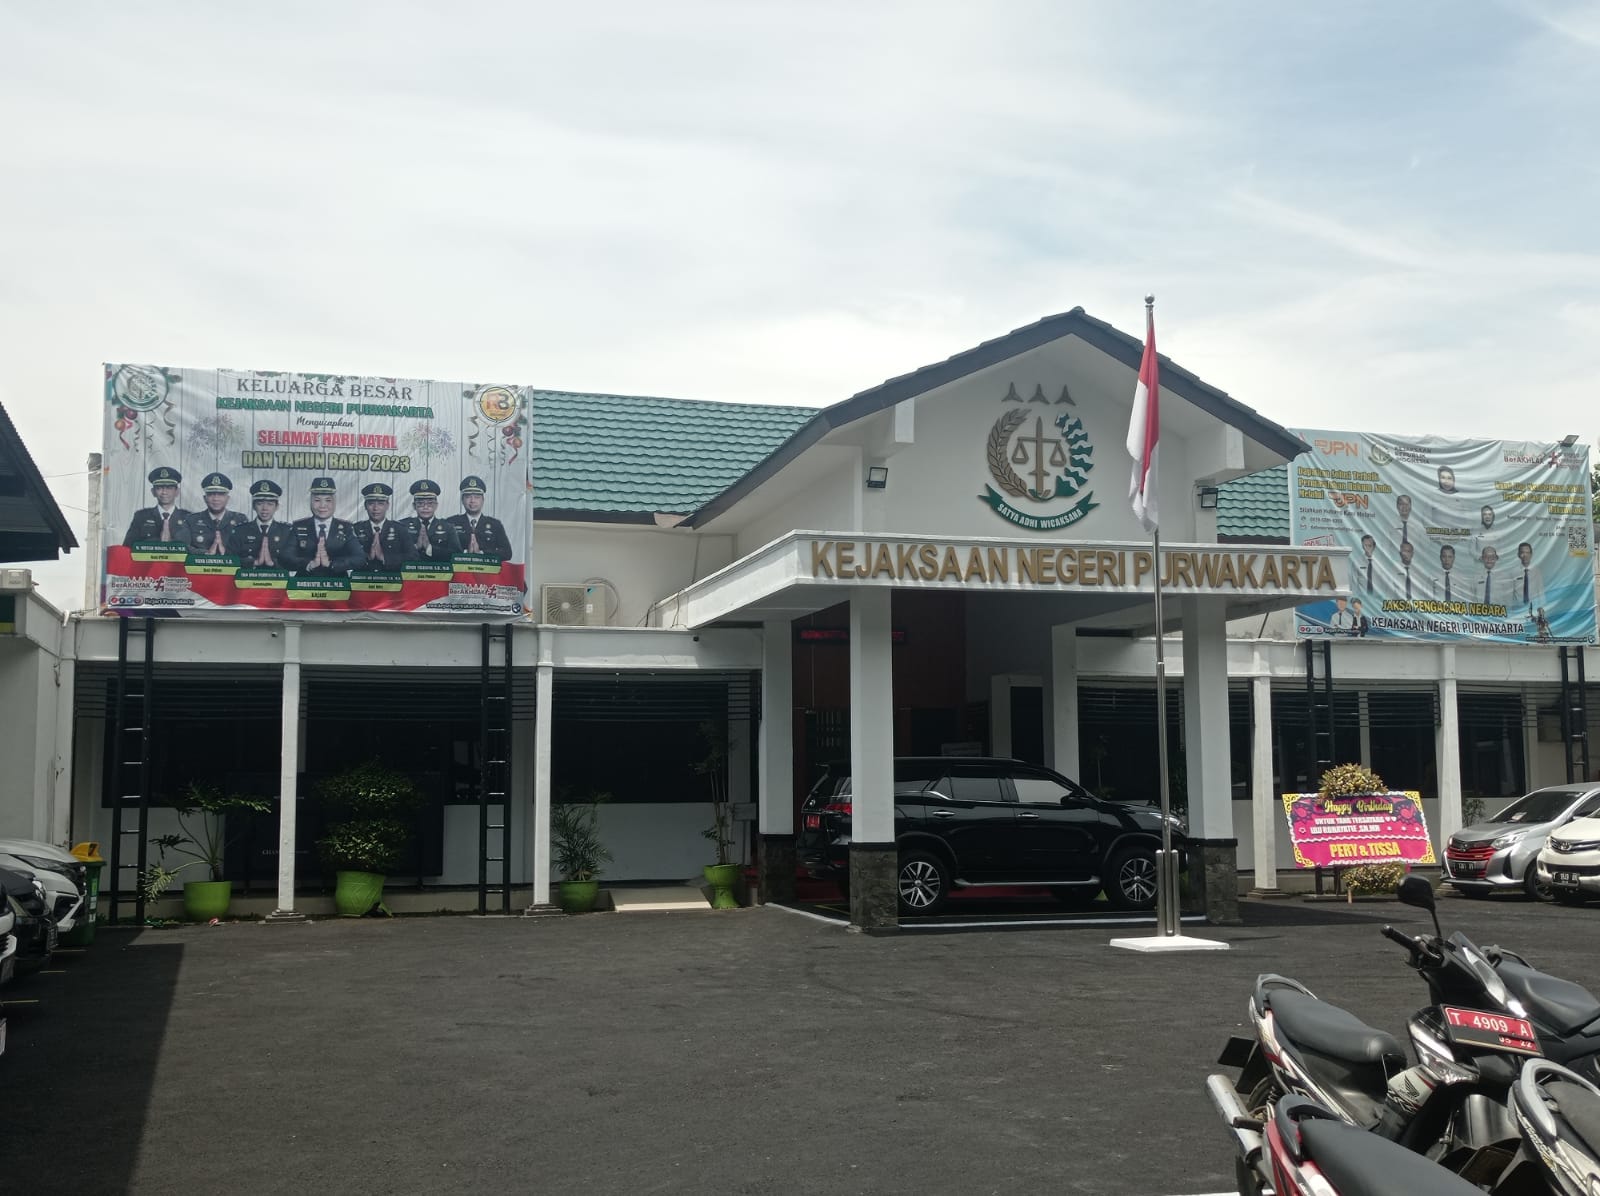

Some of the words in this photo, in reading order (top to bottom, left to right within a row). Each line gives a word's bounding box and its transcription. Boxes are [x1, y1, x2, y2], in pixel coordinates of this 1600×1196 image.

[236, 378, 344, 396] KELUARGA
[350, 383, 413, 401] BESAR
[216, 396, 291, 412] KEJAKSAAN
[294, 399, 343, 414] NEGERI
[346, 403, 434, 419] PURWAKARTA
[258, 429, 319, 447] SELAMAT
[321, 432, 356, 449] HARI
[357, 433, 398, 450] NATAL
[241, 450, 274, 469] DAN
[275, 451, 326, 469] TAHUN
[328, 453, 369, 471] BARU
[370, 454, 411, 473] 2023
[997, 503, 1018, 522] SATYA
[1019, 517, 1038, 529] ADHI
[1040, 508, 1084, 529] WICAKSANA
[811, 540, 1009, 583] KEJAKSAAN
[1016, 547, 1126, 587] NEGERI
[1133, 550, 1337, 591] PURWAKARTA
[1382, 599, 1412, 612] JAKSA
[1413, 600, 1467, 616] PENGACARA
[1469, 603, 1507, 617] NEGARA
[1371, 617, 1424, 631] KEJAKSAAN
[1426, 619, 1461, 633] NEGERI
[1462, 622, 1524, 635] PURWAKARTA
[1324, 799, 1352, 815] Happy
[1356, 800, 1393, 815] Birthday
[1368, 842, 1401, 857] TISSA
[1451, 1012, 1461, 1025] T
[1473, 1015, 1508, 1034] 4909
[1520, 1024, 1529, 1037] A
